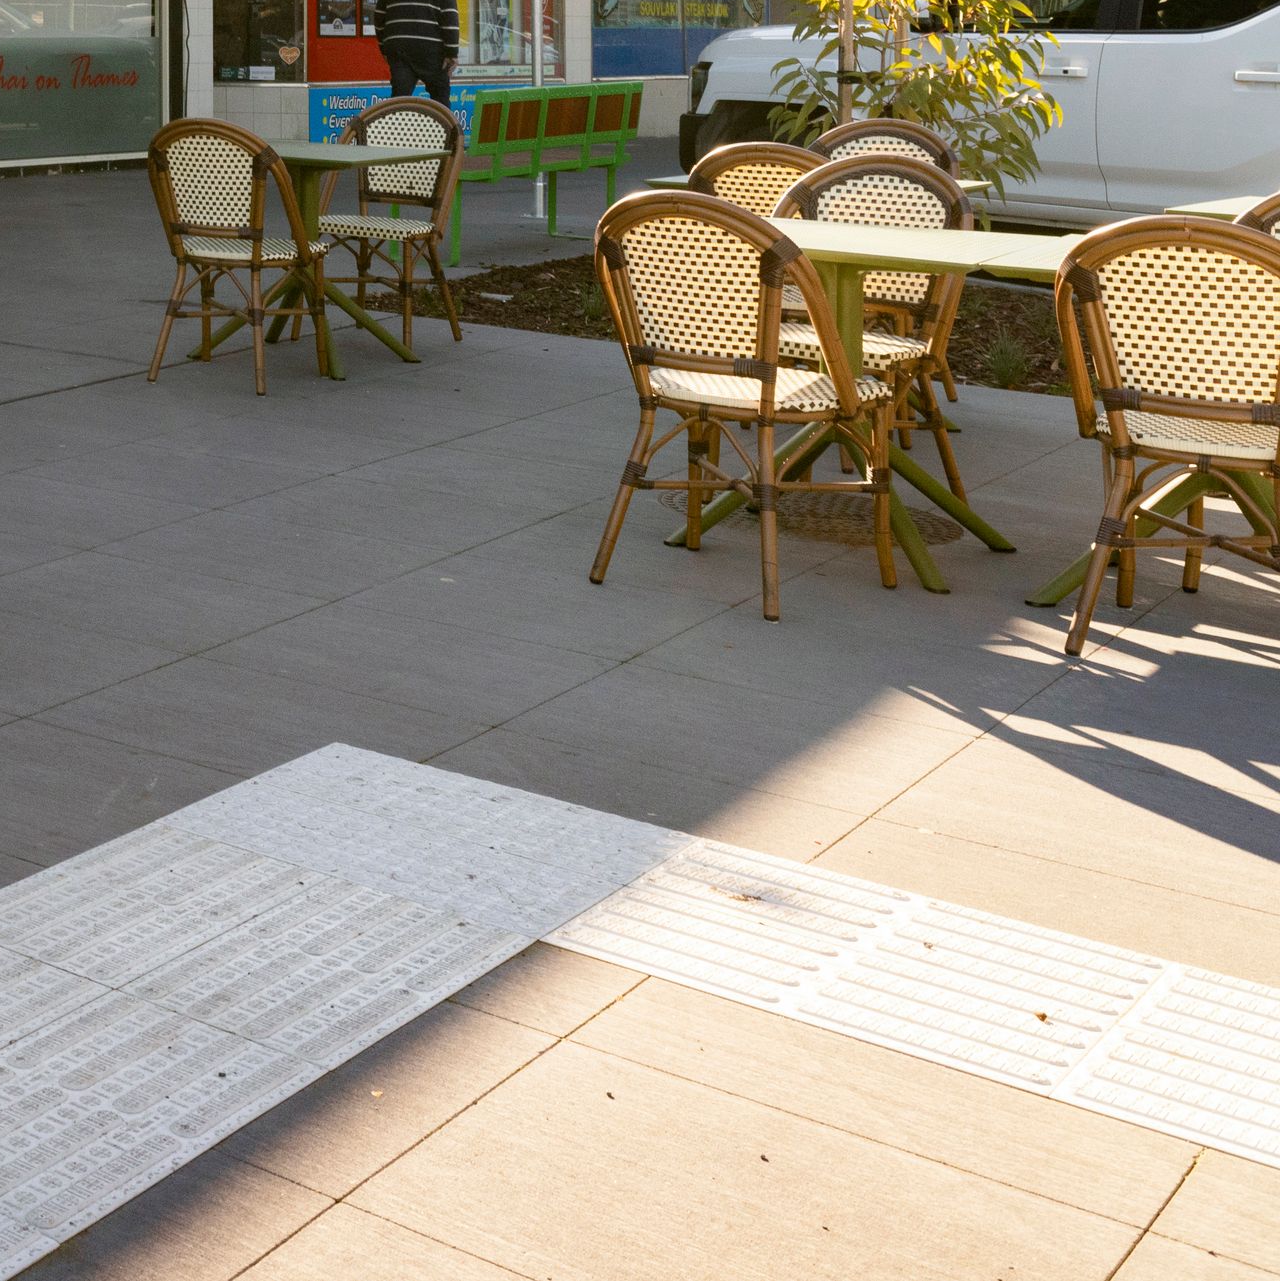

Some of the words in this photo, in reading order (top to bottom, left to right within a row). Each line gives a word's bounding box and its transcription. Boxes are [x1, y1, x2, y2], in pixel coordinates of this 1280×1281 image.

[35, 69, 61, 90] on
[71, 54, 139, 89] Thames
[329, 95, 367, 112] Wedding
[329, 114, 354, 128] Even
